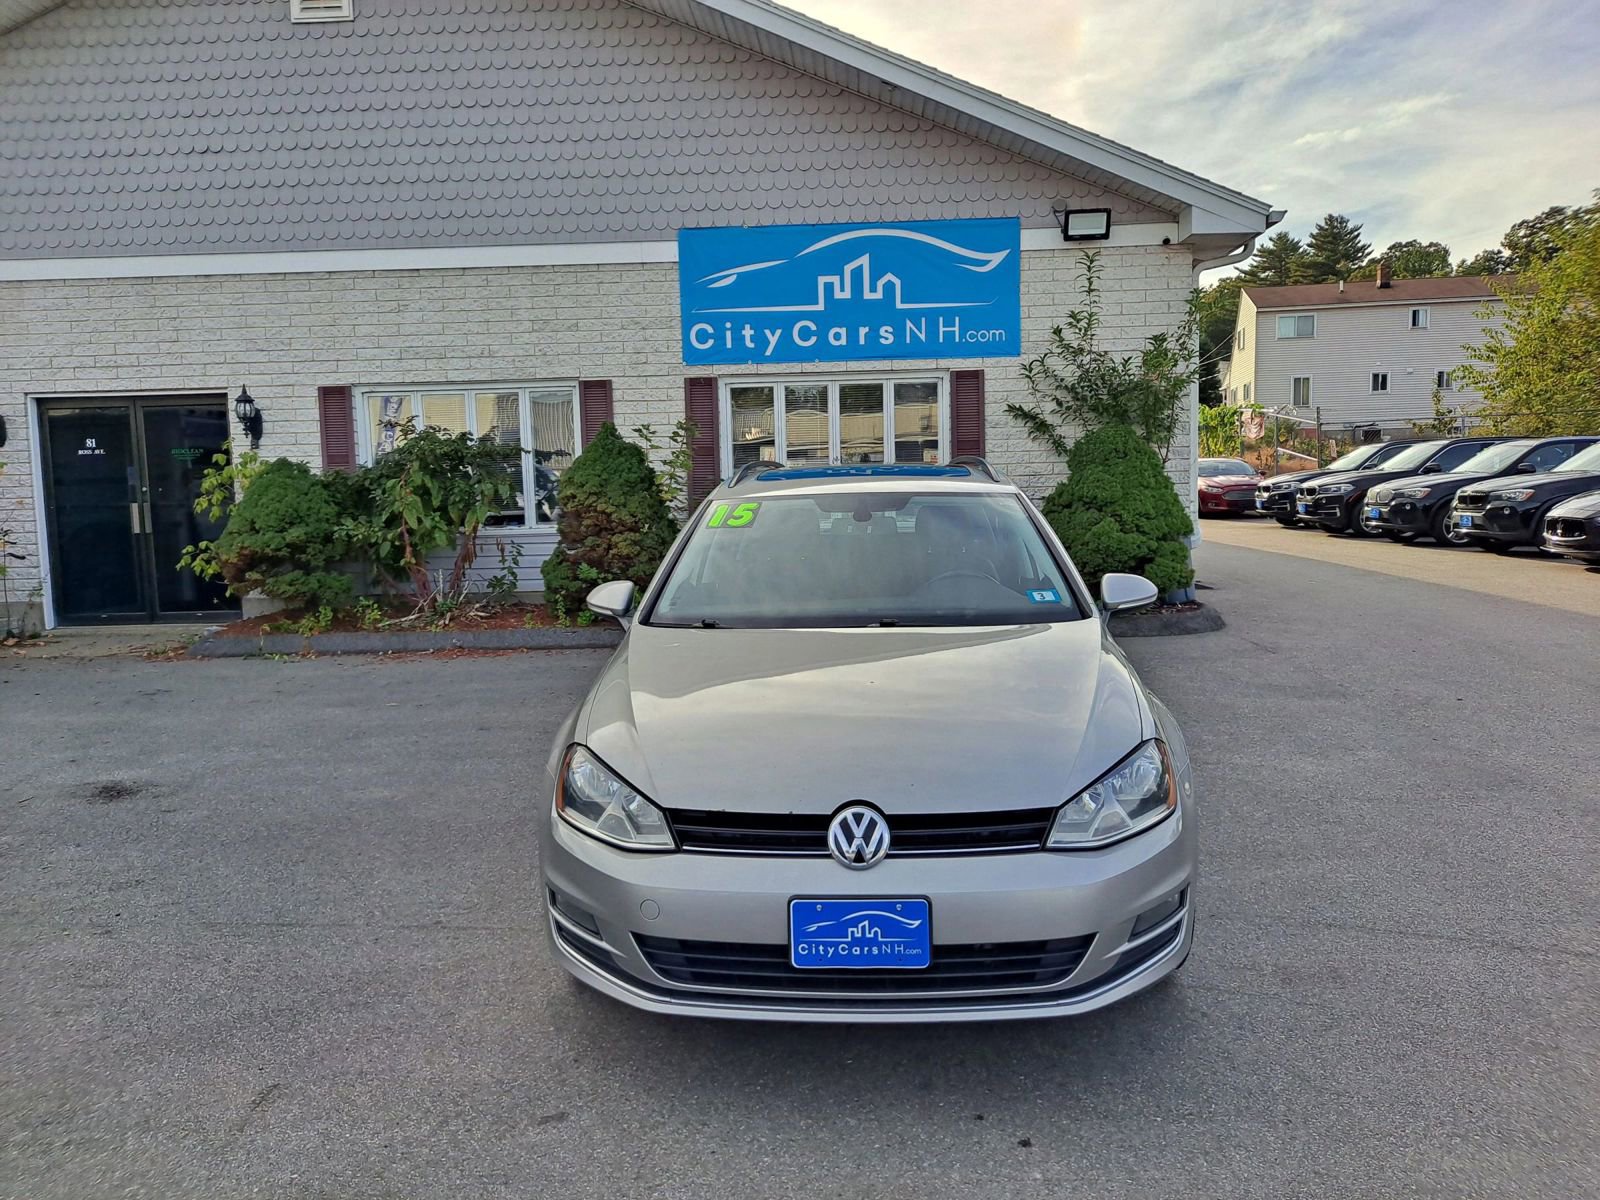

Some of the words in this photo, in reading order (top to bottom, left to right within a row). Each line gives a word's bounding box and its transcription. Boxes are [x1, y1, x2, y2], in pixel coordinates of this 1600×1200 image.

[86, 438, 97, 448] 81
[708, 502, 760, 528] 15
[829, 807, 889, 868] VW
